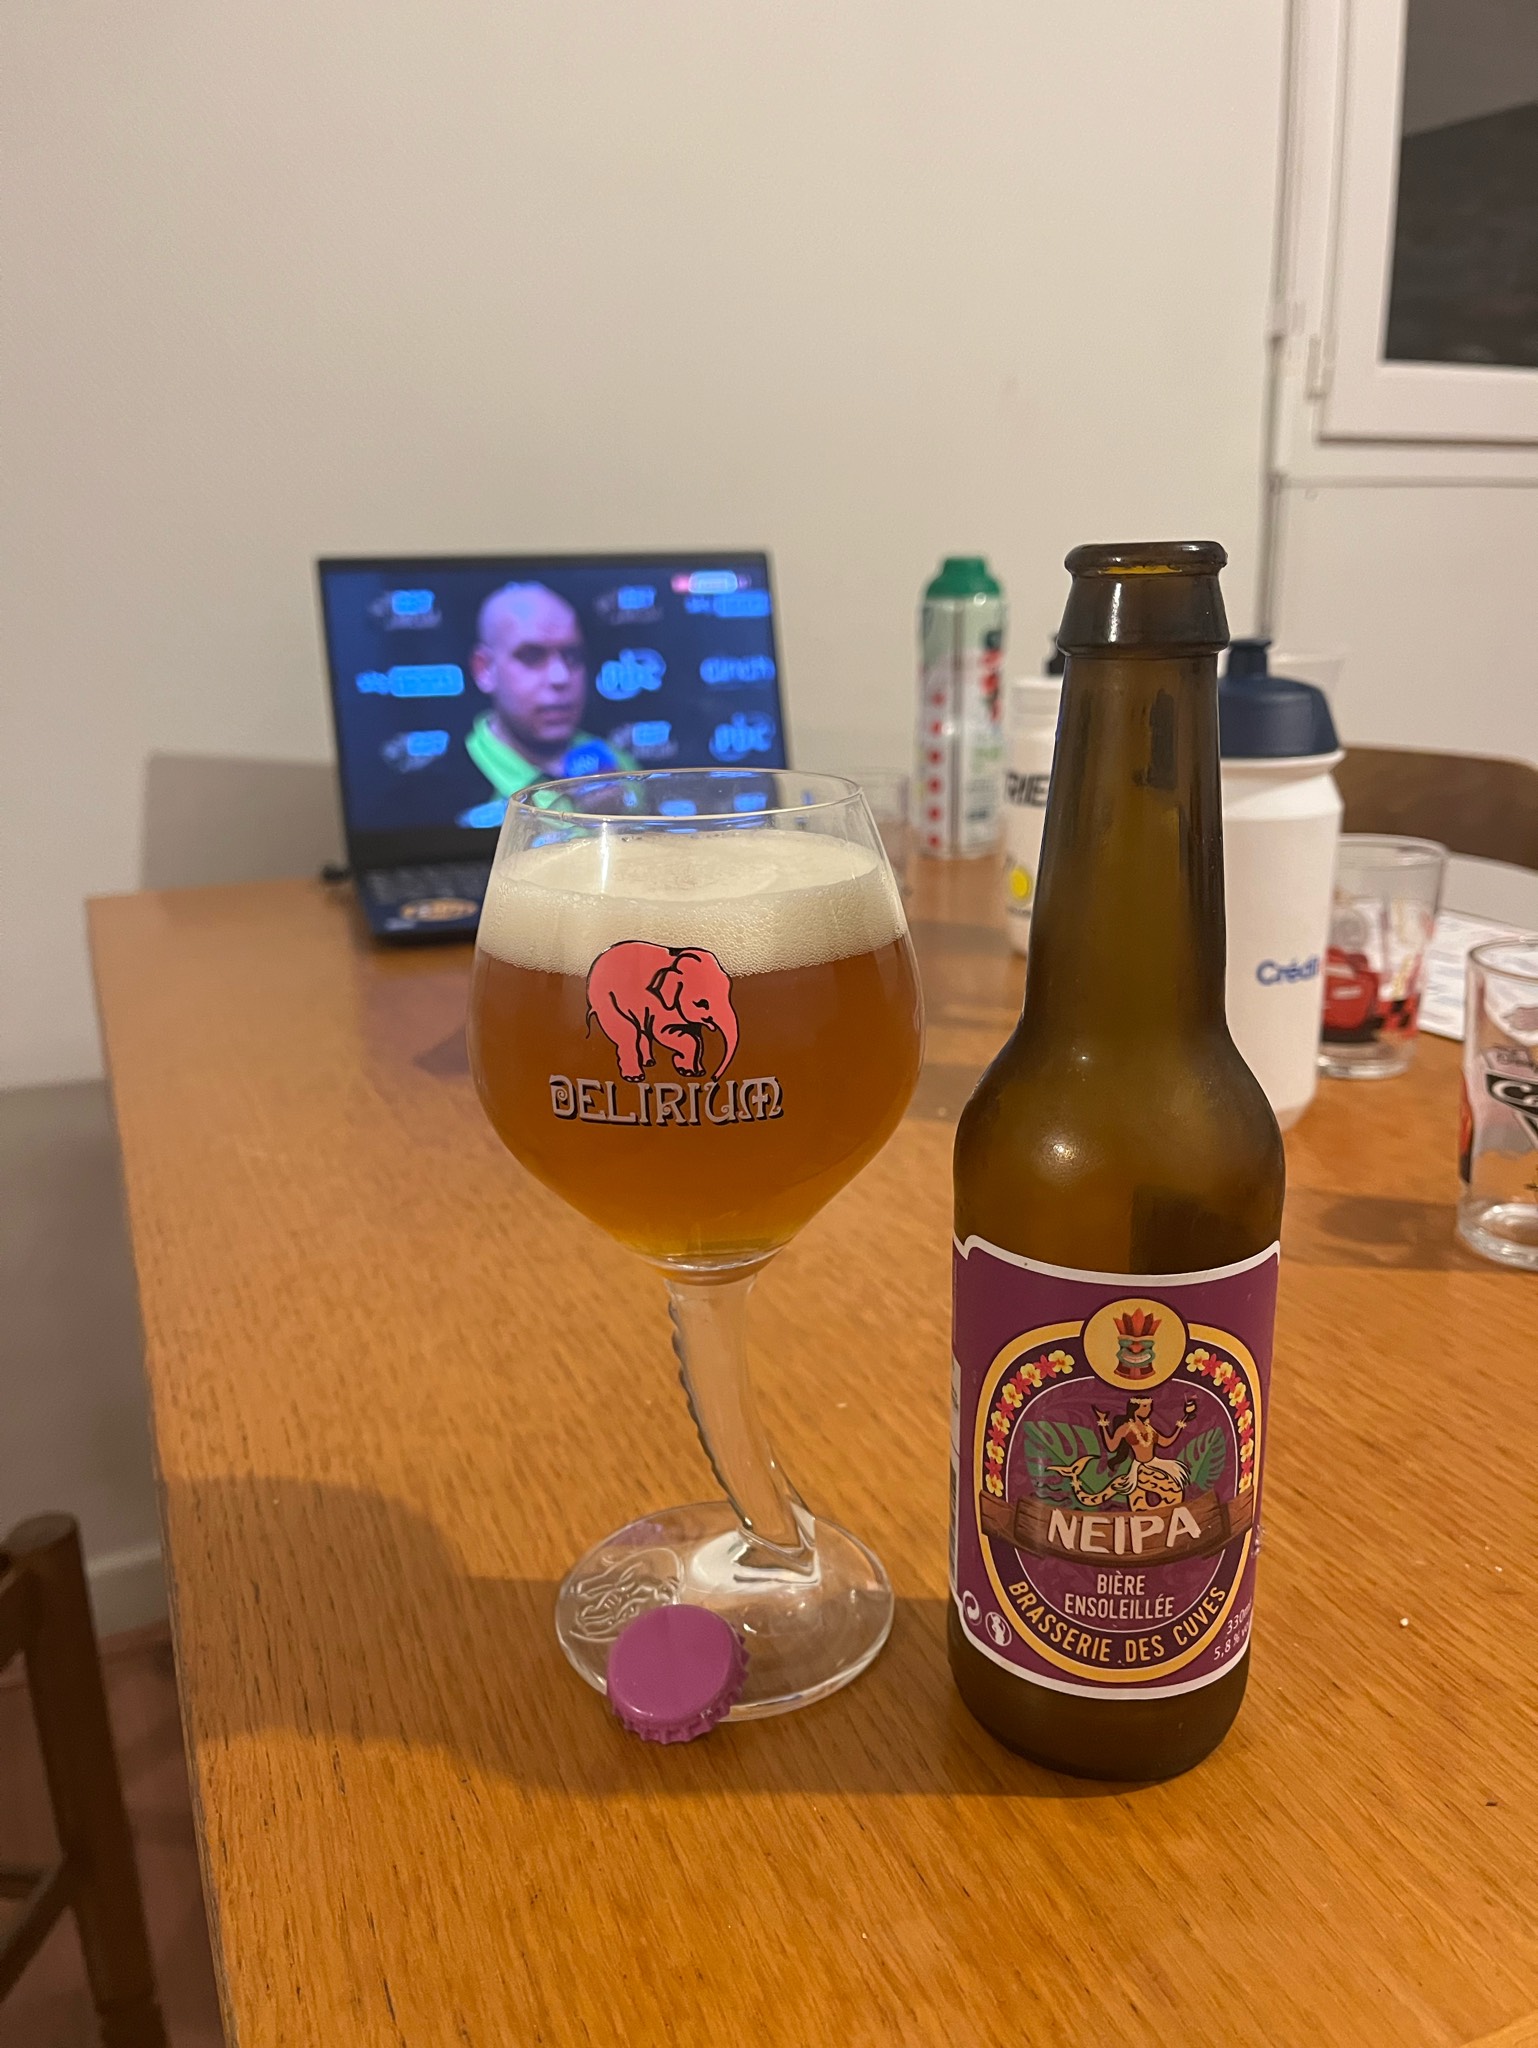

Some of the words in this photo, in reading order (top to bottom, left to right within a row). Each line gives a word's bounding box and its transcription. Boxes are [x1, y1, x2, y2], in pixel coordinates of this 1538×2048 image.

[549, 1074, 784, 1127] DELIRIUM
[1047, 1506, 1202, 1556] NEIPA
[1064, 1593, 1175, 1620] ENSOLEILLÉE
[1096, 1570, 1146, 1596] BIÈRE
[1008, 1580, 1113, 1663] BRASSERIE
[1125, 1635, 1165, 1663] DES
[1172, 1586, 1226, 1646] CUVES
